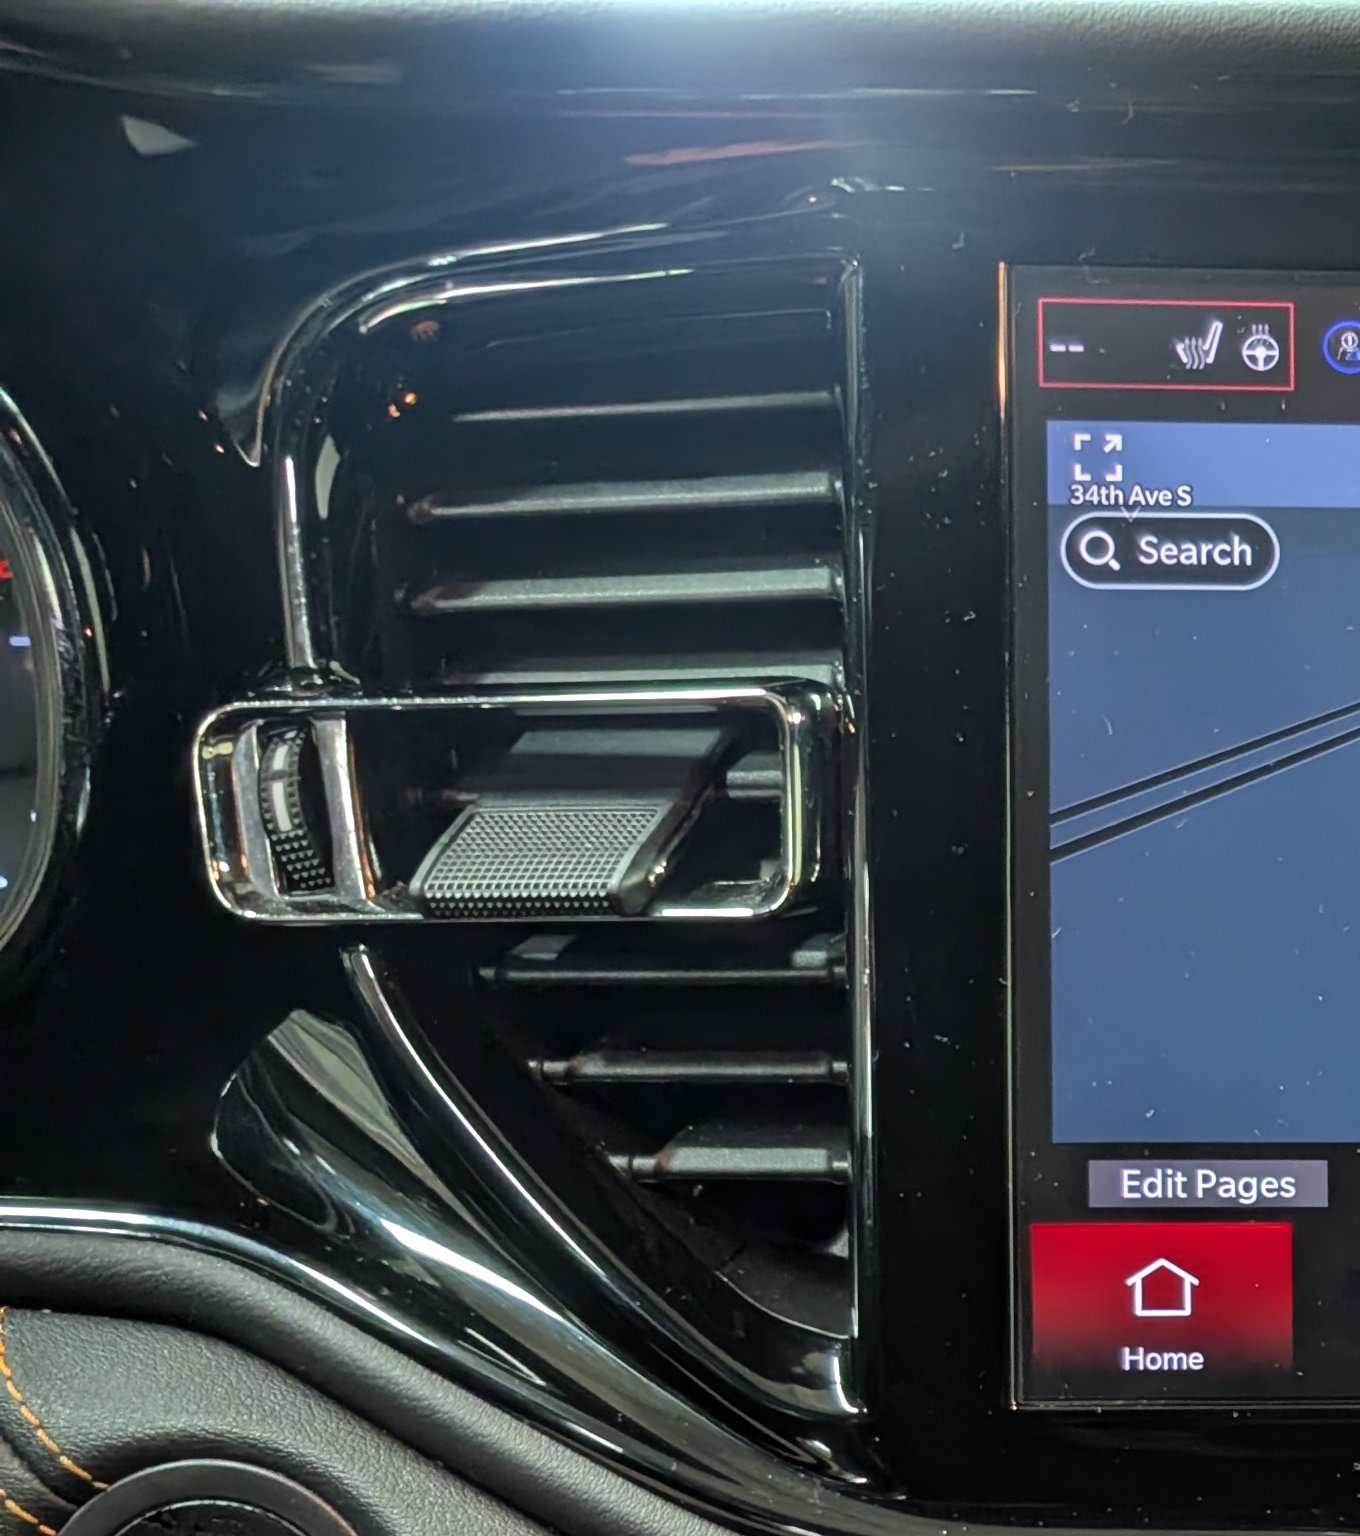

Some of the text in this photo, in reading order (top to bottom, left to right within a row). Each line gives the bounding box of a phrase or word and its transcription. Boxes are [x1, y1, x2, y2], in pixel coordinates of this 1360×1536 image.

[1069, 483, 1193, 507] 34th Ave S
[1138, 534, 1253, 567] Search
[1122, 1168, 1296, 1205] Edit Pages
[1122, 1346, 1204, 1371] Home
